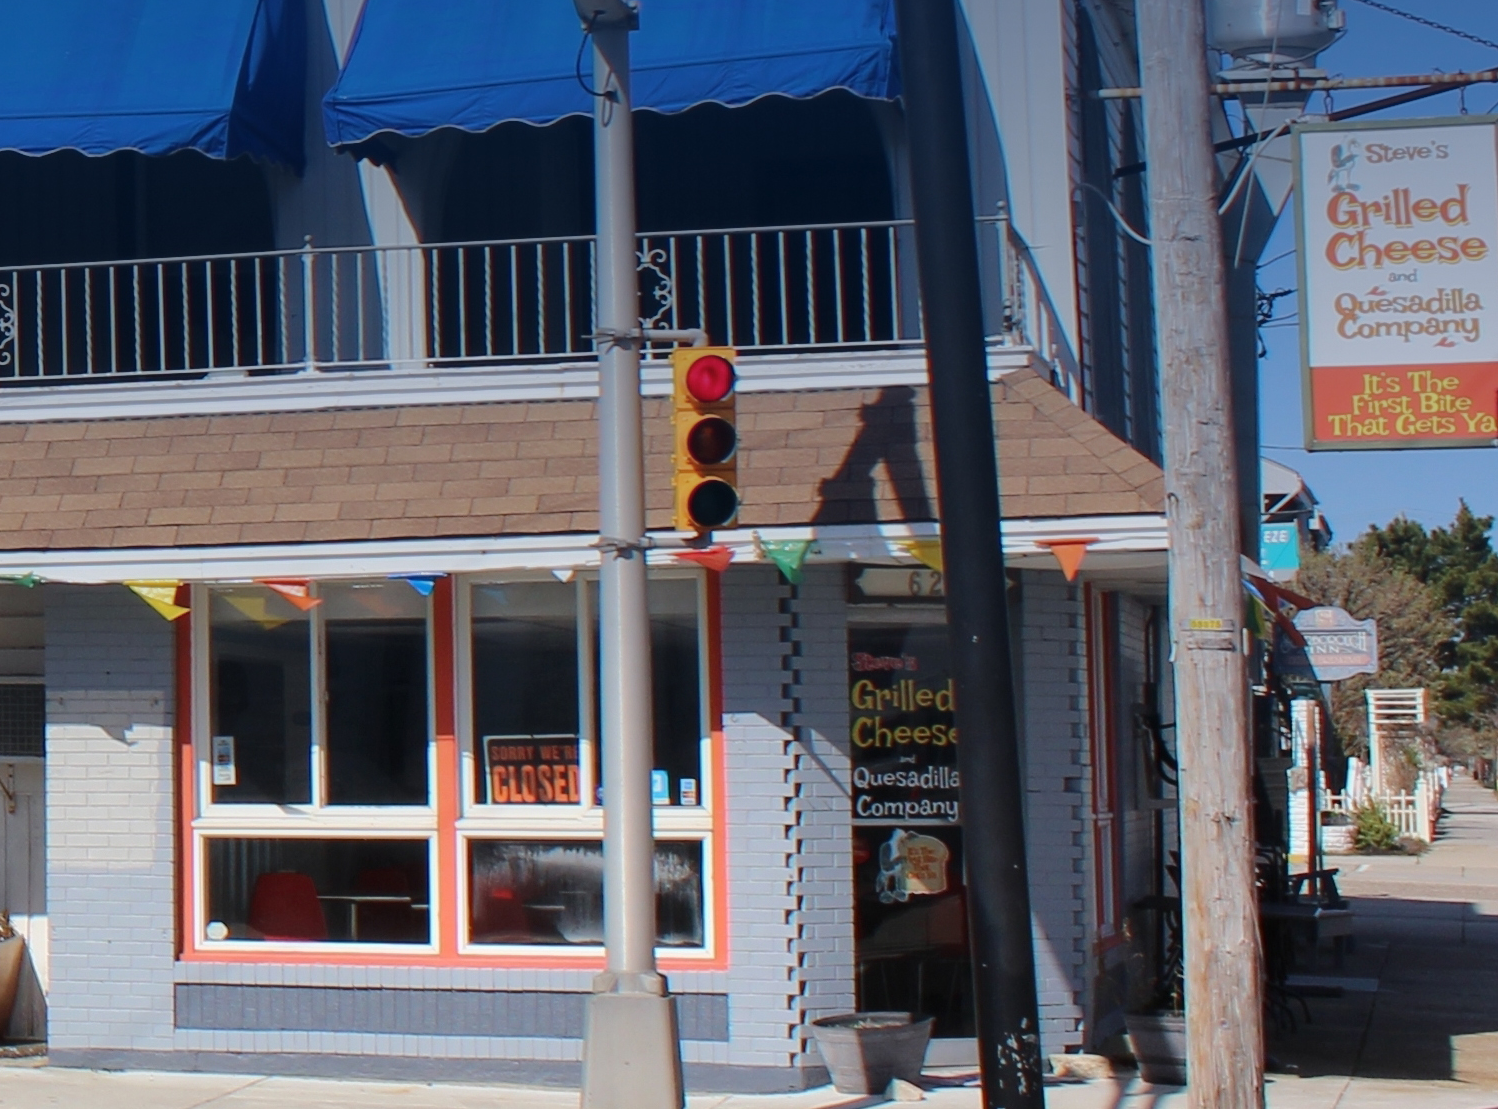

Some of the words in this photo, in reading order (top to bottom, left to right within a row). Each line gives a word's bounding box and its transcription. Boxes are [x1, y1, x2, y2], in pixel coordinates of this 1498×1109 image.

[1364, 139, 1450, 164] Steve's
[1324, 183, 1471, 230] Grilled
[1324, 230, 1489, 271] Cheese
[1387, 268, 1418, 283] and
[1334, 287, 1484, 317] Quesadilla
[1335, 315, 1481, 348] Company
[1362, 372, 1401, 396] It's
[1407, 370, 1459, 392] The
[1352, 393, 1413, 416] First
[1419, 391, 1472, 412] Bite
[1327, 414, 1390, 437] That
[1395, 412, 1456, 436] Gets
[1460, 411, 1497, 434] Ya
[907, 571, 942, 596] 62
[1309, 644, 1340, 654] INN
[851, 678, 957, 712] Grilled
[851, 715, 959, 748] Cheese
[491, 746, 534, 761] SORRY
[492, 764, 580, 803] CLOSED
[852, 765, 960, 790] Quesadilla
[856, 794, 959, 823] Company
